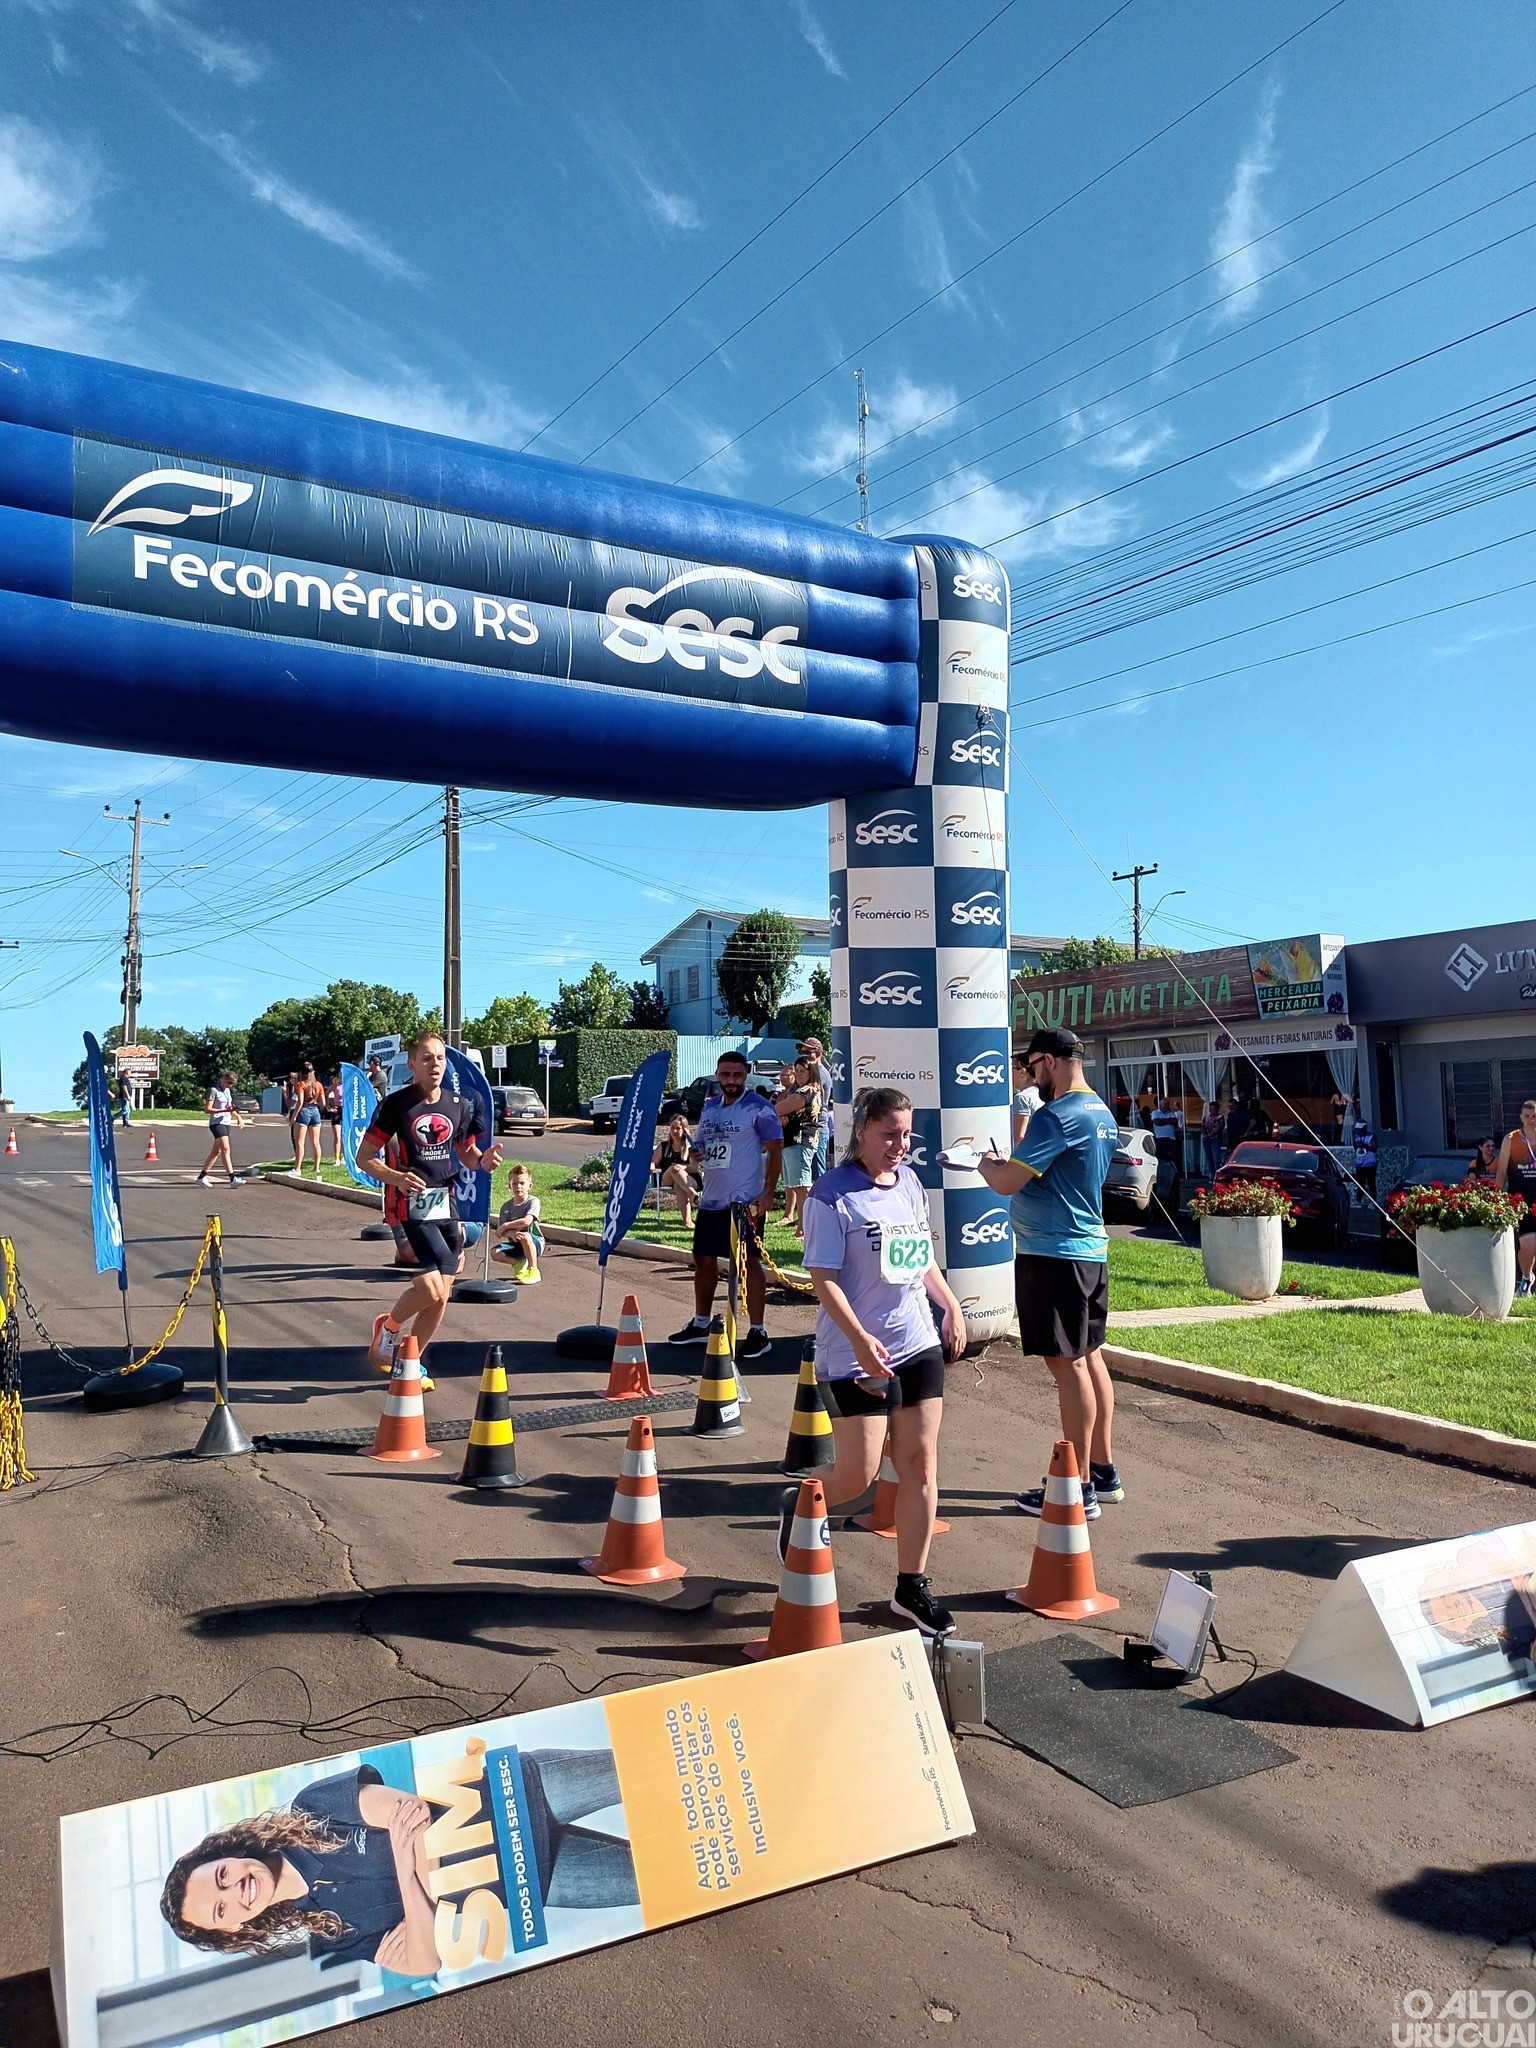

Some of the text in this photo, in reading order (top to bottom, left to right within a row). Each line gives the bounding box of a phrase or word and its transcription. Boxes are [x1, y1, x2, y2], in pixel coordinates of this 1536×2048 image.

[133, 534, 540, 645] Fecomércio RS
[953, 565, 1003, 606] Sesc
[602, 566, 801, 684] Sesc
[951, 664, 999, 681] Fecomércio
[950, 730, 1001, 767] Sesc
[855, 809, 918, 845] Sesc
[946, 828, 996, 841] Fecomércio
[855, 909, 930, 920] Fecomércio RS
[951, 891, 1002, 926] Sesc
[858, 970, 922, 1006] Sesc
[950, 989, 998, 1000] Fecomércio
[1103, 973, 1232, 1015] AMETISTA
[1260, 982, 1321, 999] MERCEARIA
[1267, 997, 1319, 1012] PEIXARIA
[1012, 984, 1093, 1032] FRUTI
[1232, 1029, 1333, 1047] ARTESANATO E PEDRAS NATURAIS
[858, 1067, 934, 1080] Fecomércio RS
[955, 1050, 1005, 1085] Sesc
[622, 1073, 644, 1148] Fecomércio
[415, 1192, 444, 1210] 574
[602, 1160, 631, 1246] Sesc
[961, 1208, 1009, 1245] Sesc
[889, 1238, 930, 1269] 623
[962, 1306, 1007, 1319] Fecomércio
[915, 1712, 930, 1756] Sindicatos
[697, 1706, 742, 1876] serviços do Sesc.
[725, 1712, 768, 1855] Inclusive você.
[928, 1767, 937, 1780] RS
[666, 1708, 713, 1890] Aqui, todo mundo
[680, 1701, 731, 1890] pode aproveitar os
[933, 1780, 952, 1831] Fecomércio
[498, 1754, 536, 1943] TODOS PODEM SER SESC.
